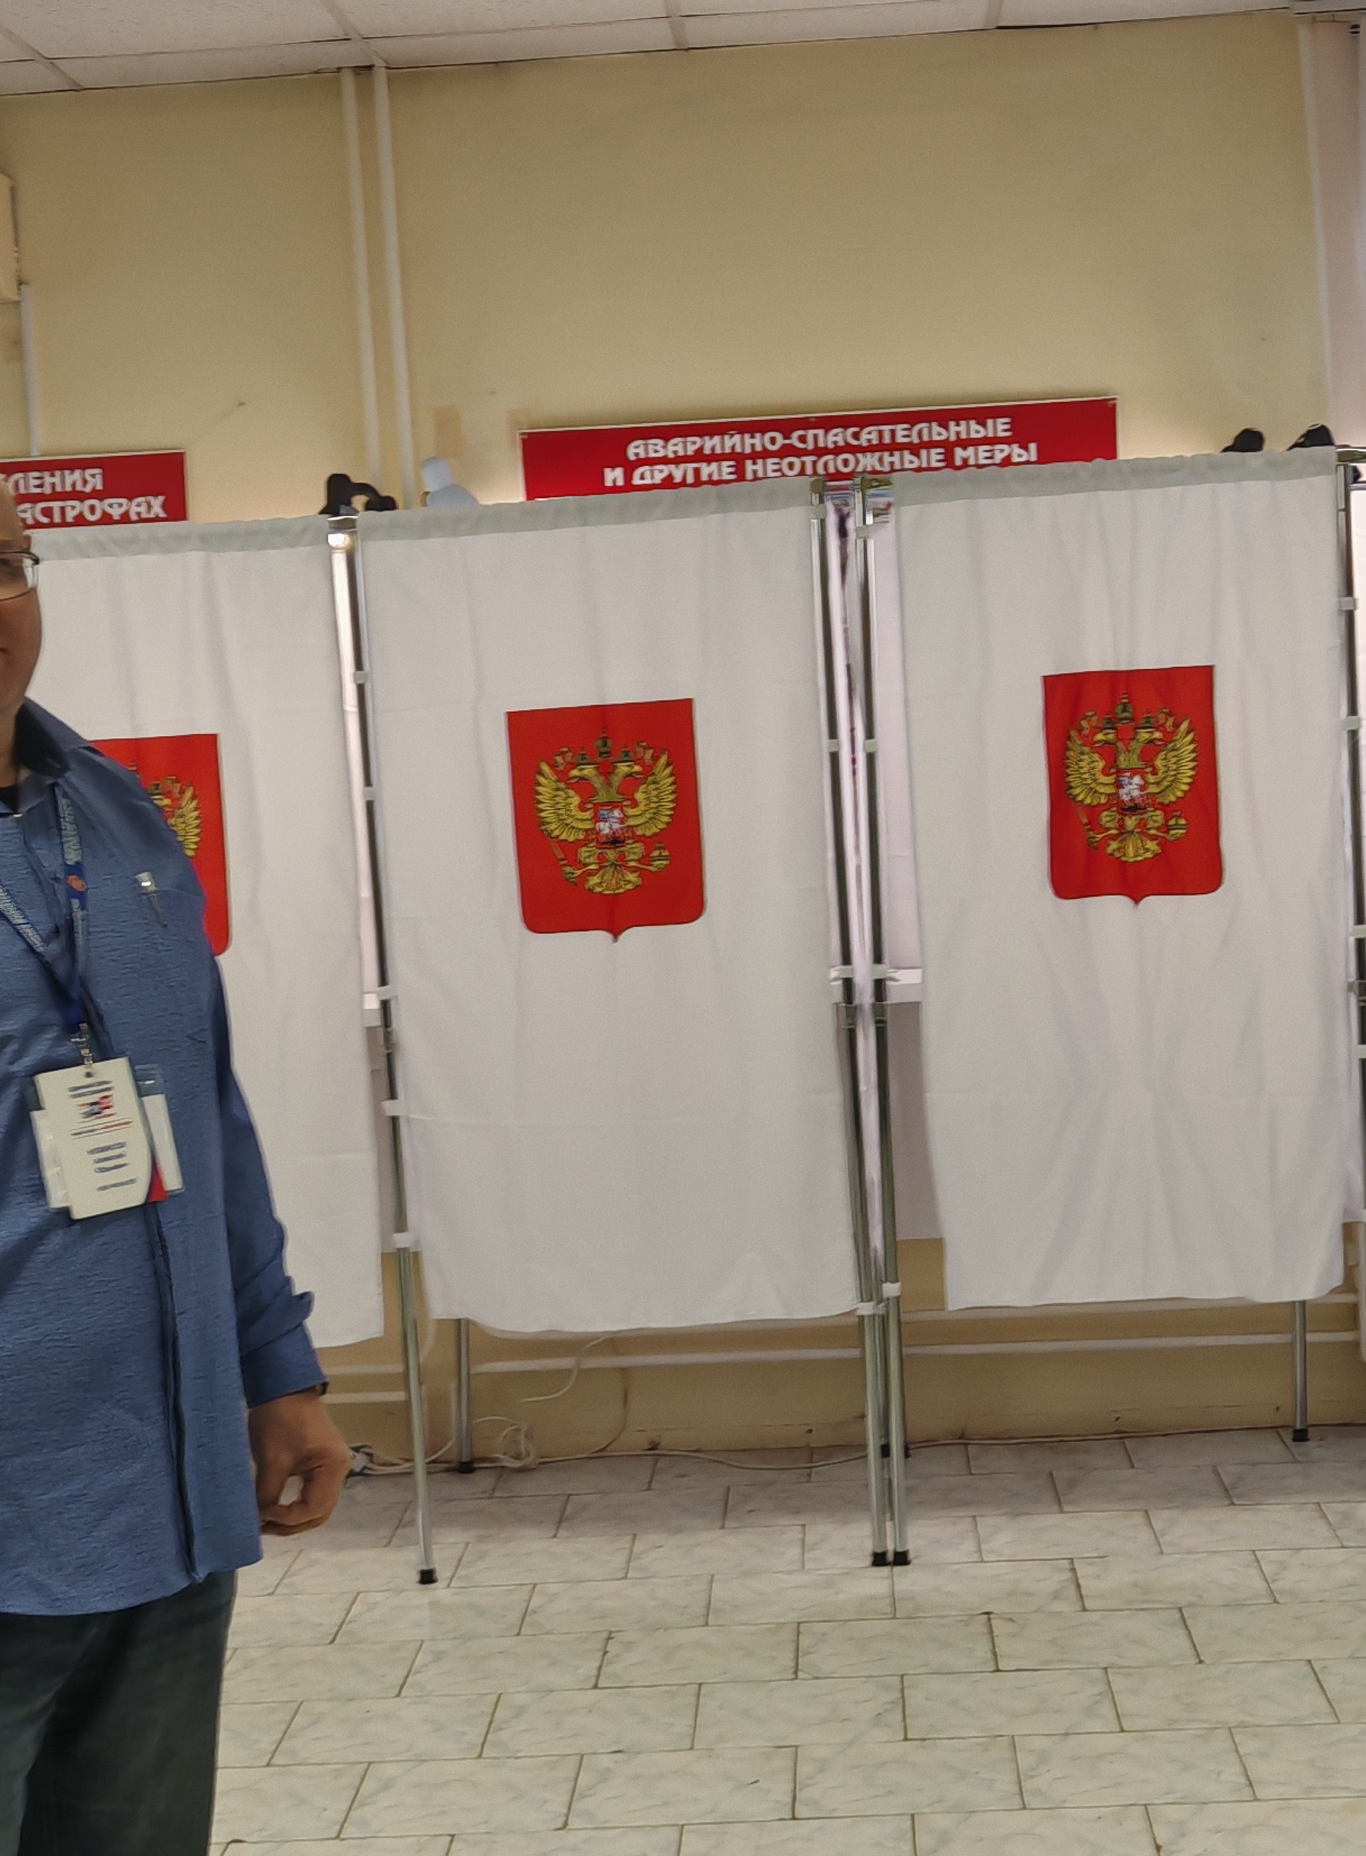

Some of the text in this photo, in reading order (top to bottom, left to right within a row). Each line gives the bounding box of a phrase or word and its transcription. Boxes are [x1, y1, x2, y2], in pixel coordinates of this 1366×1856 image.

[626, 417, 1013, 461] АВАРИЙНО-СПАСАТЕЛЬНЫЕ
[1, 468, 104, 496] ЛЕНИЯ
[603, 442, 1038, 487] И ДРУГИЕ НЕОТЛОЖНЫЕ МЕРЫ
[16, 495, 167, 525] АСТРОФАХ
